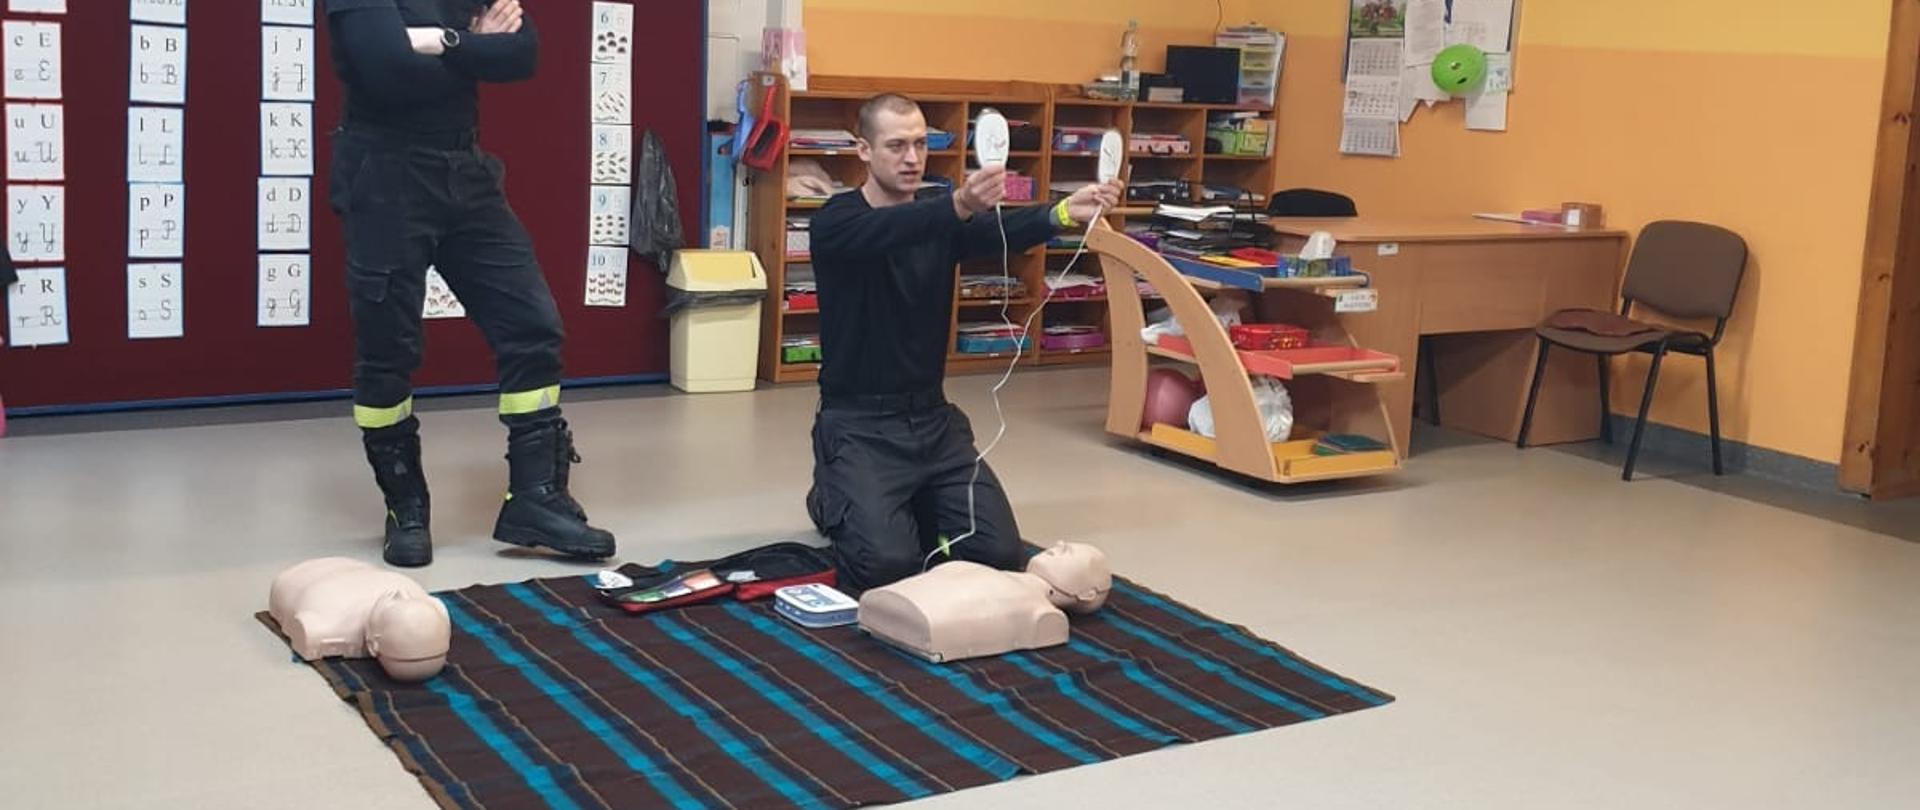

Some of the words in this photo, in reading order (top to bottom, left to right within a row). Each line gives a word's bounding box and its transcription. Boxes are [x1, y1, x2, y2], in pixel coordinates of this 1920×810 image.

[600, 11, 609, 25] 6
[13, 35, 24, 47] e
[39, 31, 52, 48] E
[140, 35, 150, 50] b
[166, 38, 177, 52] B
[14, 69, 24, 80] e
[39, 60, 50, 81] E
[140, 64, 149, 83] b
[162, 64, 177, 85] B
[599, 70, 608, 85] 7
[15, 118, 24, 128] u
[41, 114, 53, 128] U
[162, 119, 171, 133] L
[269, 112, 278, 126] k
[291, 113, 303, 127] K
[599, 132, 608, 146] 8
[15, 151, 30, 163] u
[36, 142, 57, 163] U
[270, 140, 281, 158] k
[288, 139, 306, 158] K
[140, 197, 150, 211] p
[164, 194, 173, 207] P
[266, 187, 276, 201] d
[289, 188, 301, 201] D
[598, 193, 607, 207] 9
[17, 199, 26, 214] y
[42, 195, 54, 210] Y
[266, 214, 278, 233] d
[286, 213, 301, 233] D
[17, 233, 28, 252] y
[40, 223, 54, 252] Y
[140, 229, 149, 248] p
[162, 220, 175, 240] P
[591, 253, 606, 266] 10
[138, 278, 147, 288] s
[161, 274, 171, 287] S
[267, 268, 276, 281] g
[288, 264, 300, 277] G
[41, 279, 53, 293] R
[40, 306, 61, 326] R
[160, 299, 171, 320] S
